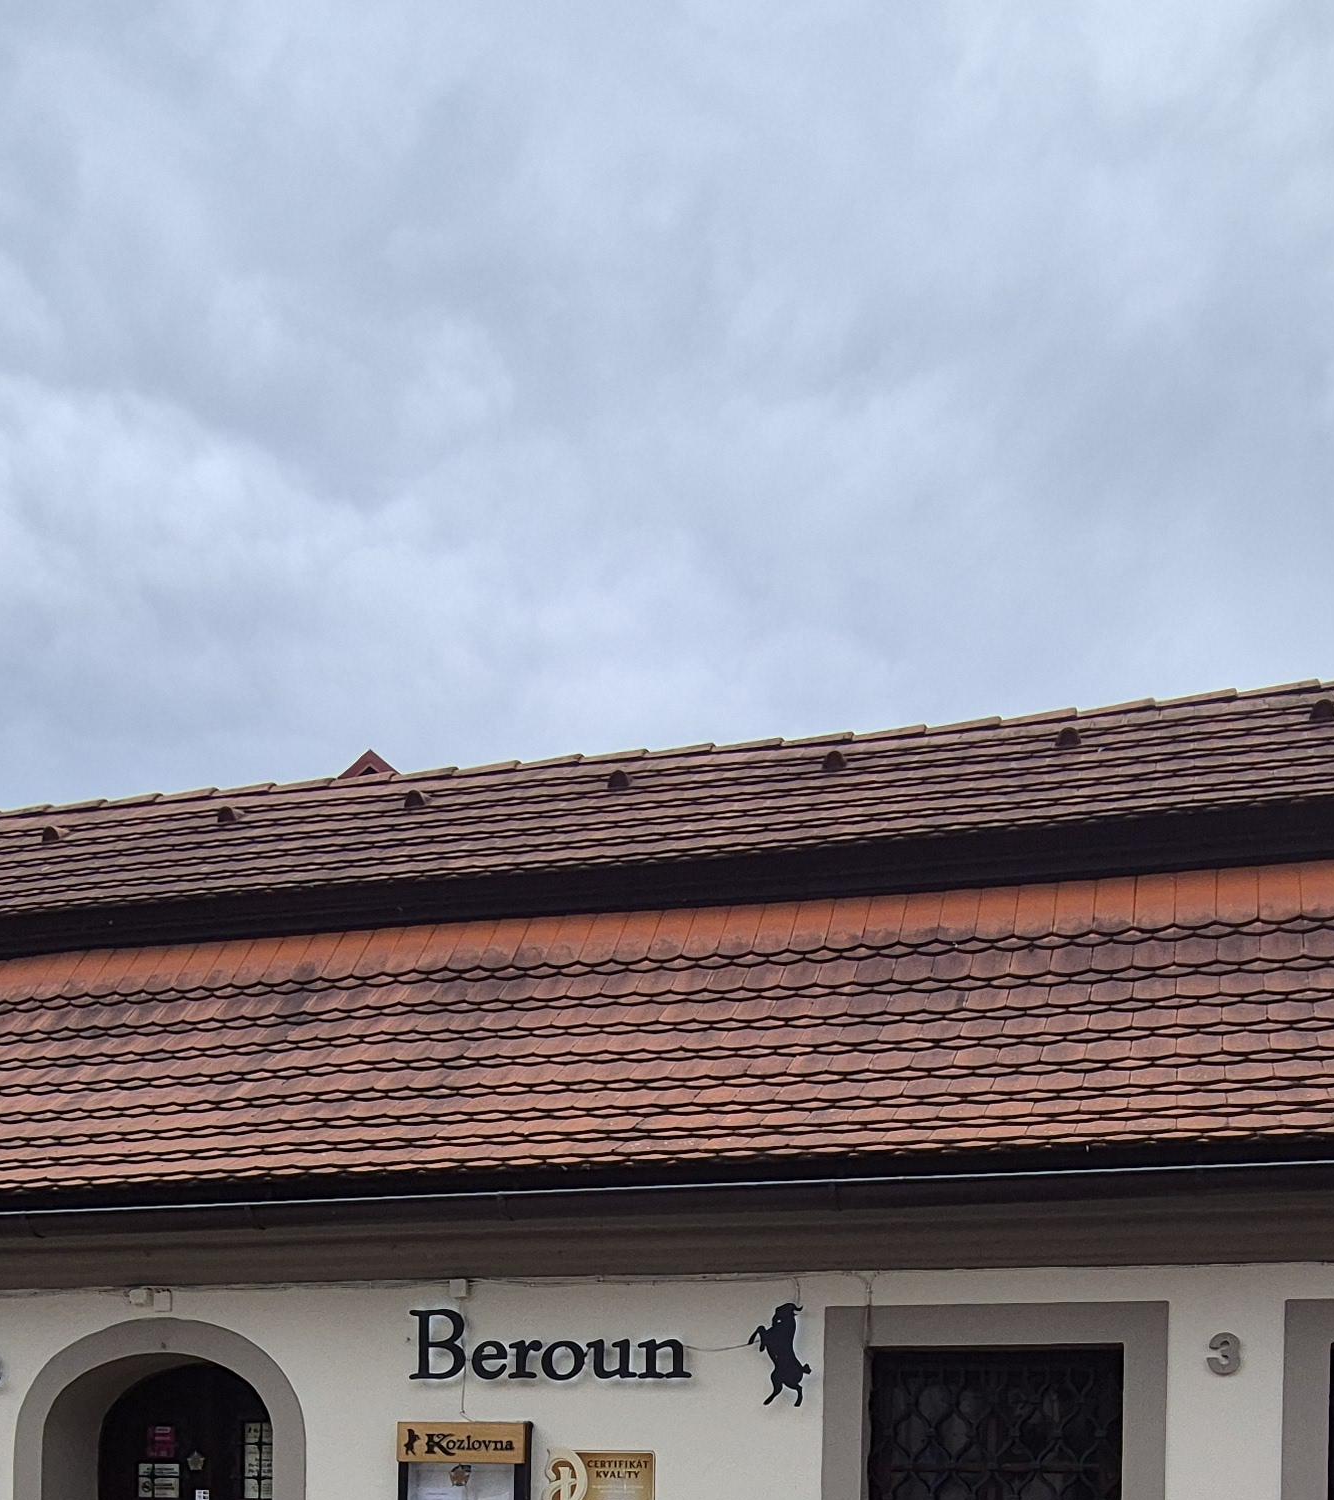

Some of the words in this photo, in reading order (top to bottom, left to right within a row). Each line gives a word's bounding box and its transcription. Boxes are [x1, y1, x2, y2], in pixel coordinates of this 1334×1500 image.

[408, 1308, 693, 1381] Beroun
[1206, 1331, 1241, 1375] 3
[425, 1433, 515, 1456] Kozlovna
[587, 1459, 649, 1469] CERTIFIKÁT
